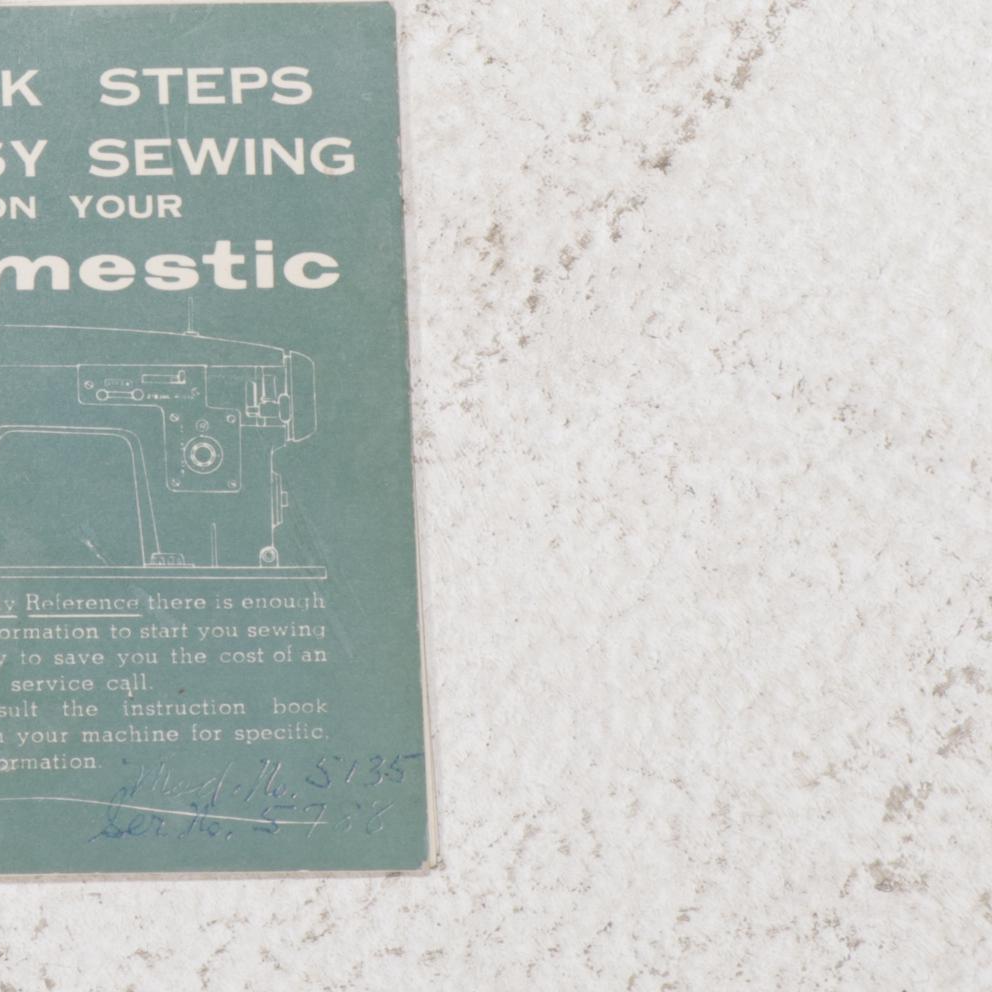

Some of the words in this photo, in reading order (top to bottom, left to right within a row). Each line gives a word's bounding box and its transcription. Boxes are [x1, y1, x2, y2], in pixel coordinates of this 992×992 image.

[100, 66, 312, 106] STEPS
[88, 137, 355, 177] SEWING
[71, 194, 182, 219] YOUR
[27, 593, 140, 611] Reference
[148, 592, 205, 609] there
[215, 594, 233, 609] is
[110, 624, 131, 639] to
[140, 623, 189, 639] start
[198, 624, 238, 640] you
[247, 622, 326, 639] sewing
[20, 650, 42, 665] to
[54, 651, 104, 665] save
[117, 649, 158, 668] you
[171, 647, 210, 664] the
[220, 648, 264, 664] cost
[273, 644, 293, 663] of
[302, 648, 327, 663] an
[11, 675, 94, 692] service
[107, 673, 154, 691] call.
[63, 699, 98, 717] the
[124, 699, 246, 716] instruction
[273, 697, 328, 714] book
[17, 729, 69, 746] your
[82, 725, 179, 743] machine
[191, 724, 222, 742] for
[305, 752, 424, 789] 5135
